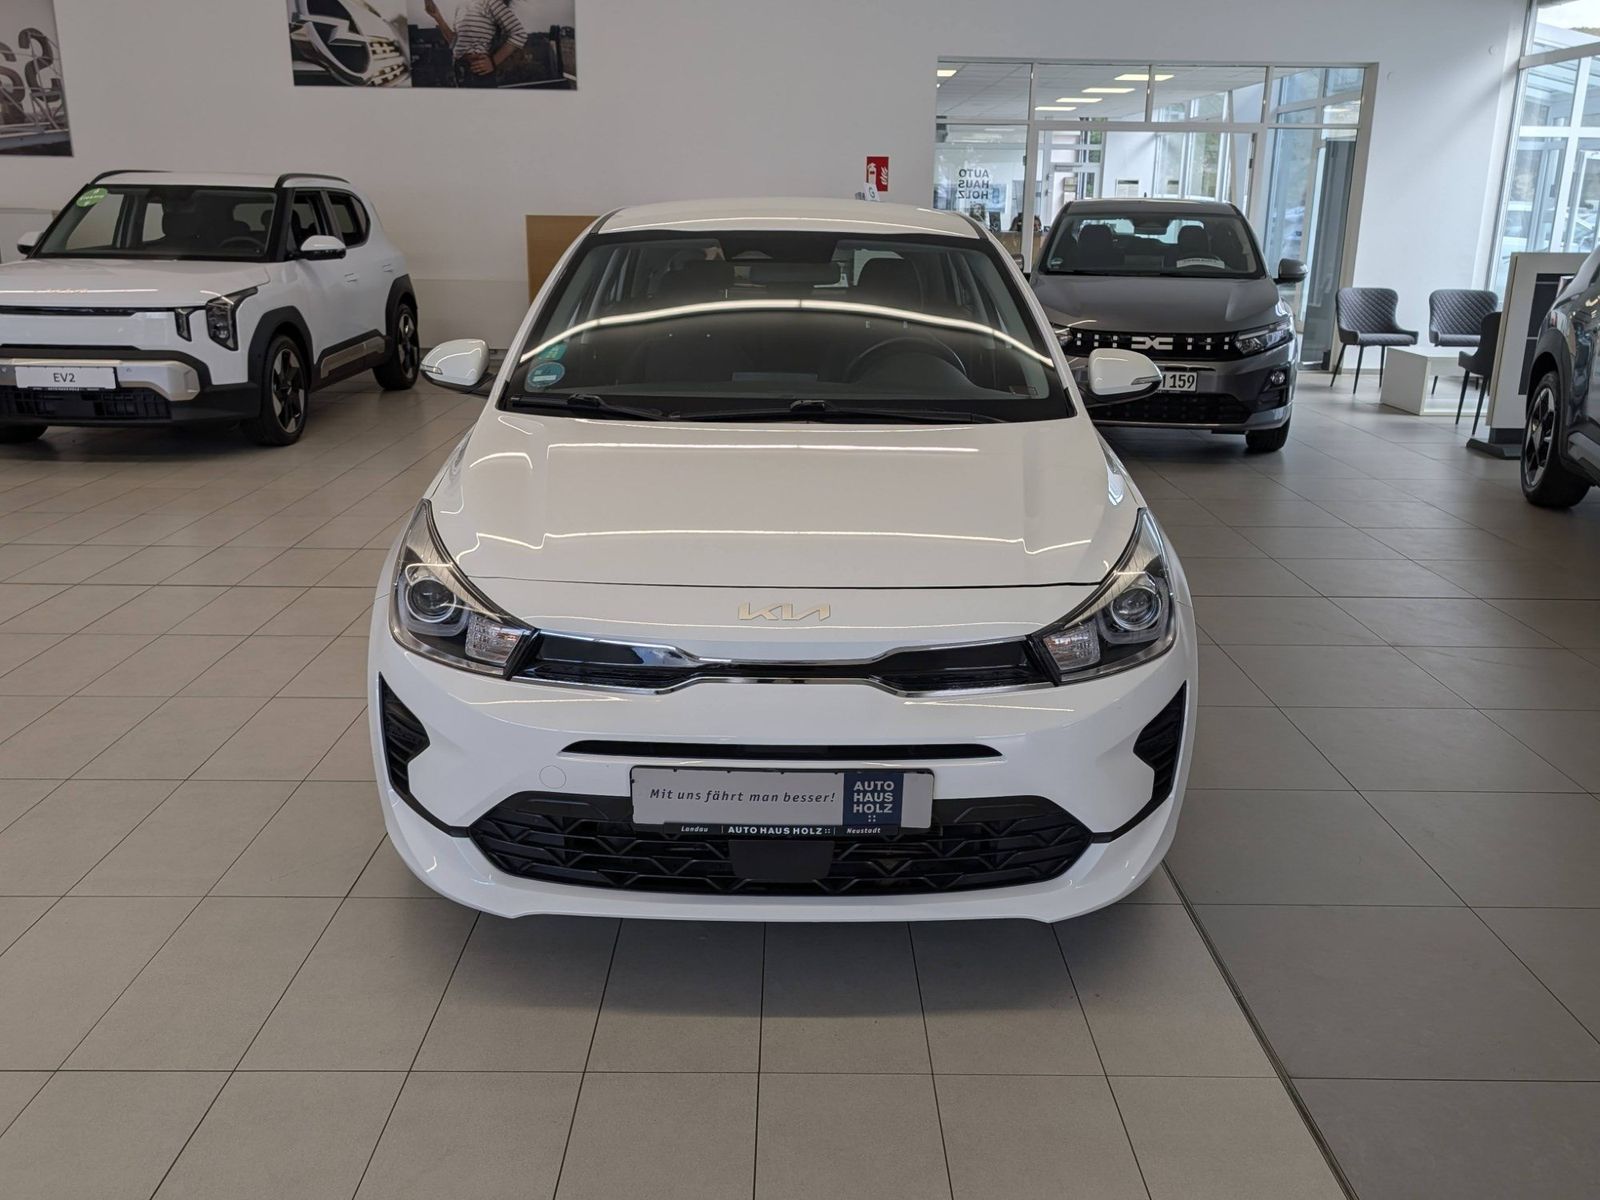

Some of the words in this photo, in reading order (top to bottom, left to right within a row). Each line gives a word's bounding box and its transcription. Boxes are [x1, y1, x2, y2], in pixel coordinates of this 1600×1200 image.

[53, 372, 76, 383] EV2
[1169, 373, 1195, 389] 159
[738, 603, 831, 621] KIA
[853, 780, 895, 791] AUTO
[649, 788, 674, 799] Mit
[677, 791, 701, 800] uns
[704, 790, 744, 803] fährt
[749, 793, 779, 802] man
[783, 791, 836, 803] besser!
[853, 792, 894, 802] HAUS
[853, 803, 893, 814] HOLZ
[680, 825, 709, 833] Landau
[793, 827, 823, 835] HOLZ
